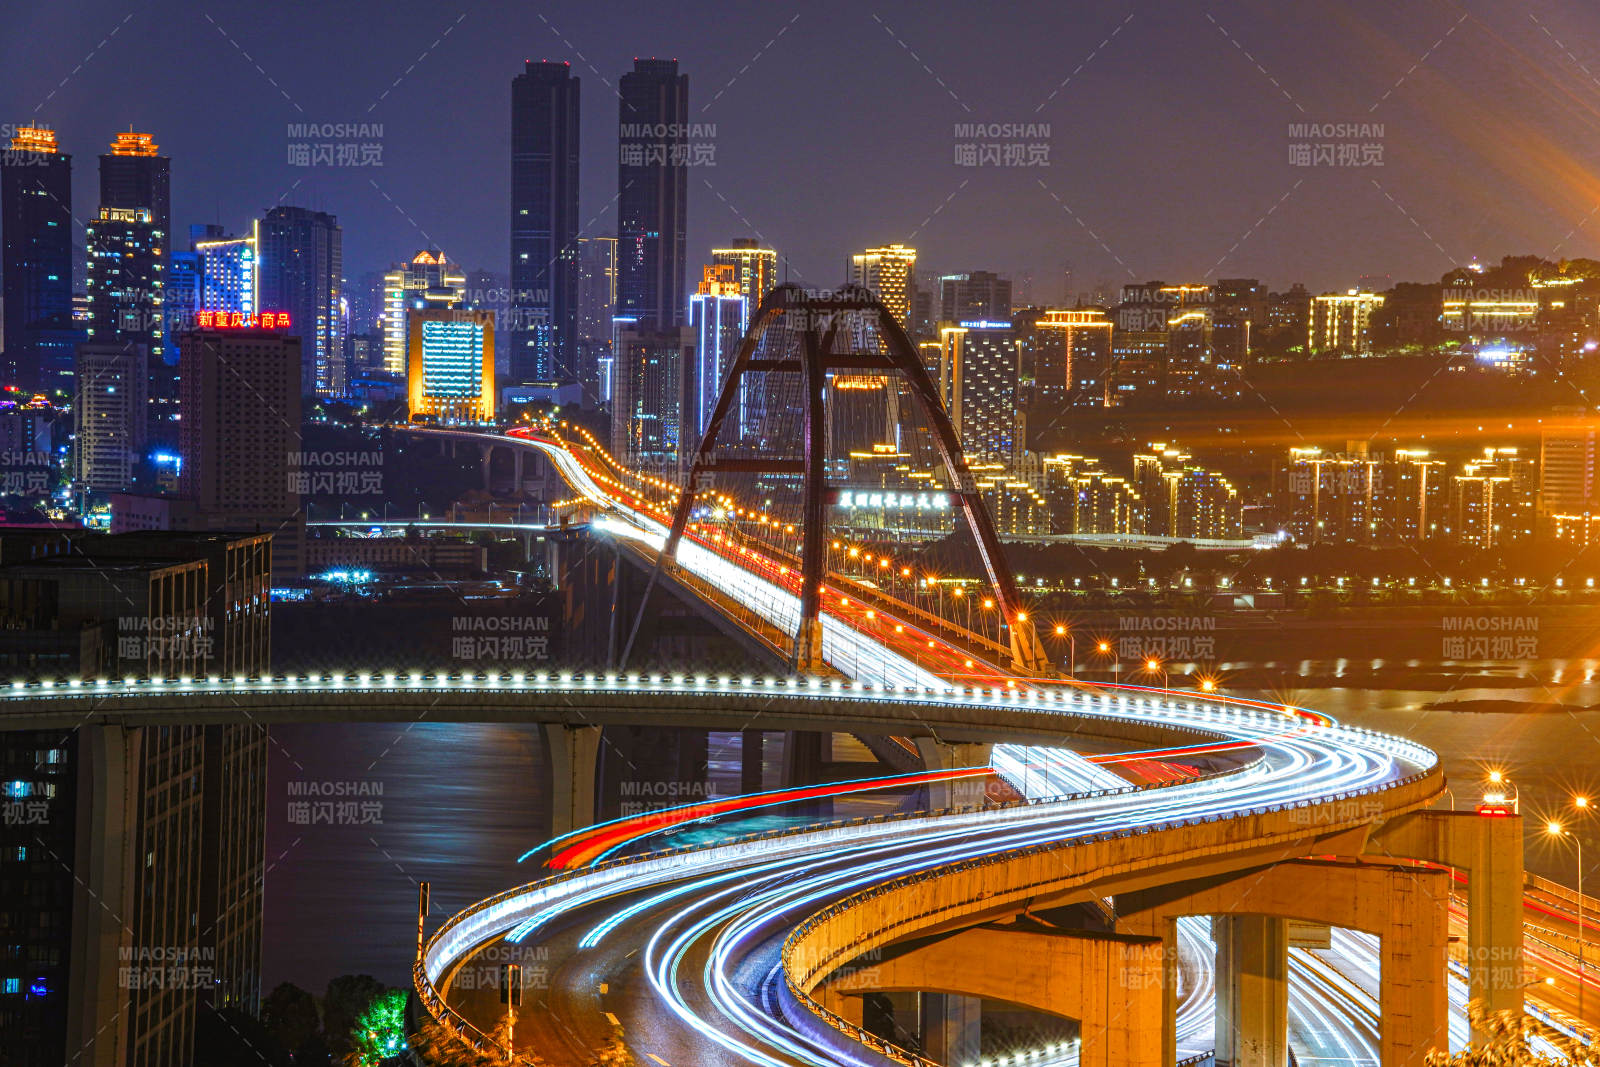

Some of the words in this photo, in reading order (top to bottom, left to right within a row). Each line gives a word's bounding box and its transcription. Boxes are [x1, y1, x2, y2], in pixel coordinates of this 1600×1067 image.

[198, 310, 291, 328] 新重庆小商品
